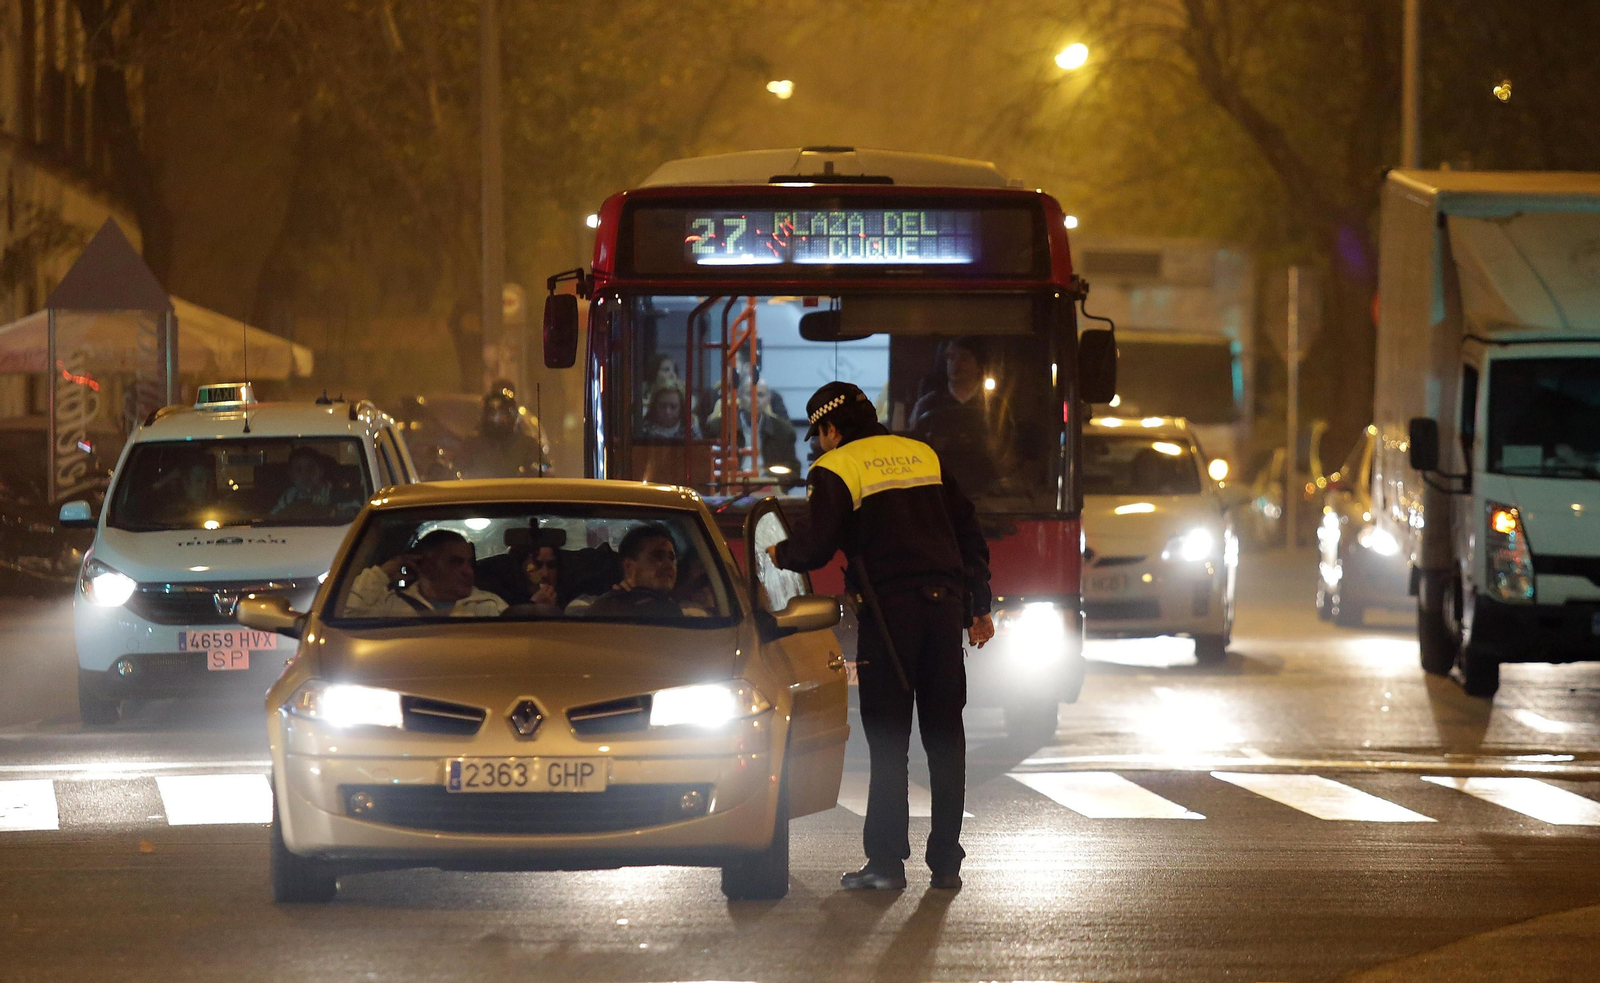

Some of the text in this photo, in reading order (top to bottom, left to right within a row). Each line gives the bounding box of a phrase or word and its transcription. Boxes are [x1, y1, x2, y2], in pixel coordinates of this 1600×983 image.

[774, 212, 938, 236] PLAZA DEL
[691, 218, 747, 254] 27
[829, 237, 920, 259] DUQUE
[209, 388, 235, 401] TAXI
[864, 455, 922, 470] POLICIA
[880, 466, 914, 476] LOCAL
[190, 631, 273, 649] 4659 HVX
[213, 651, 243, 668] SP
[465, 762, 594, 787] 2363 GHP
